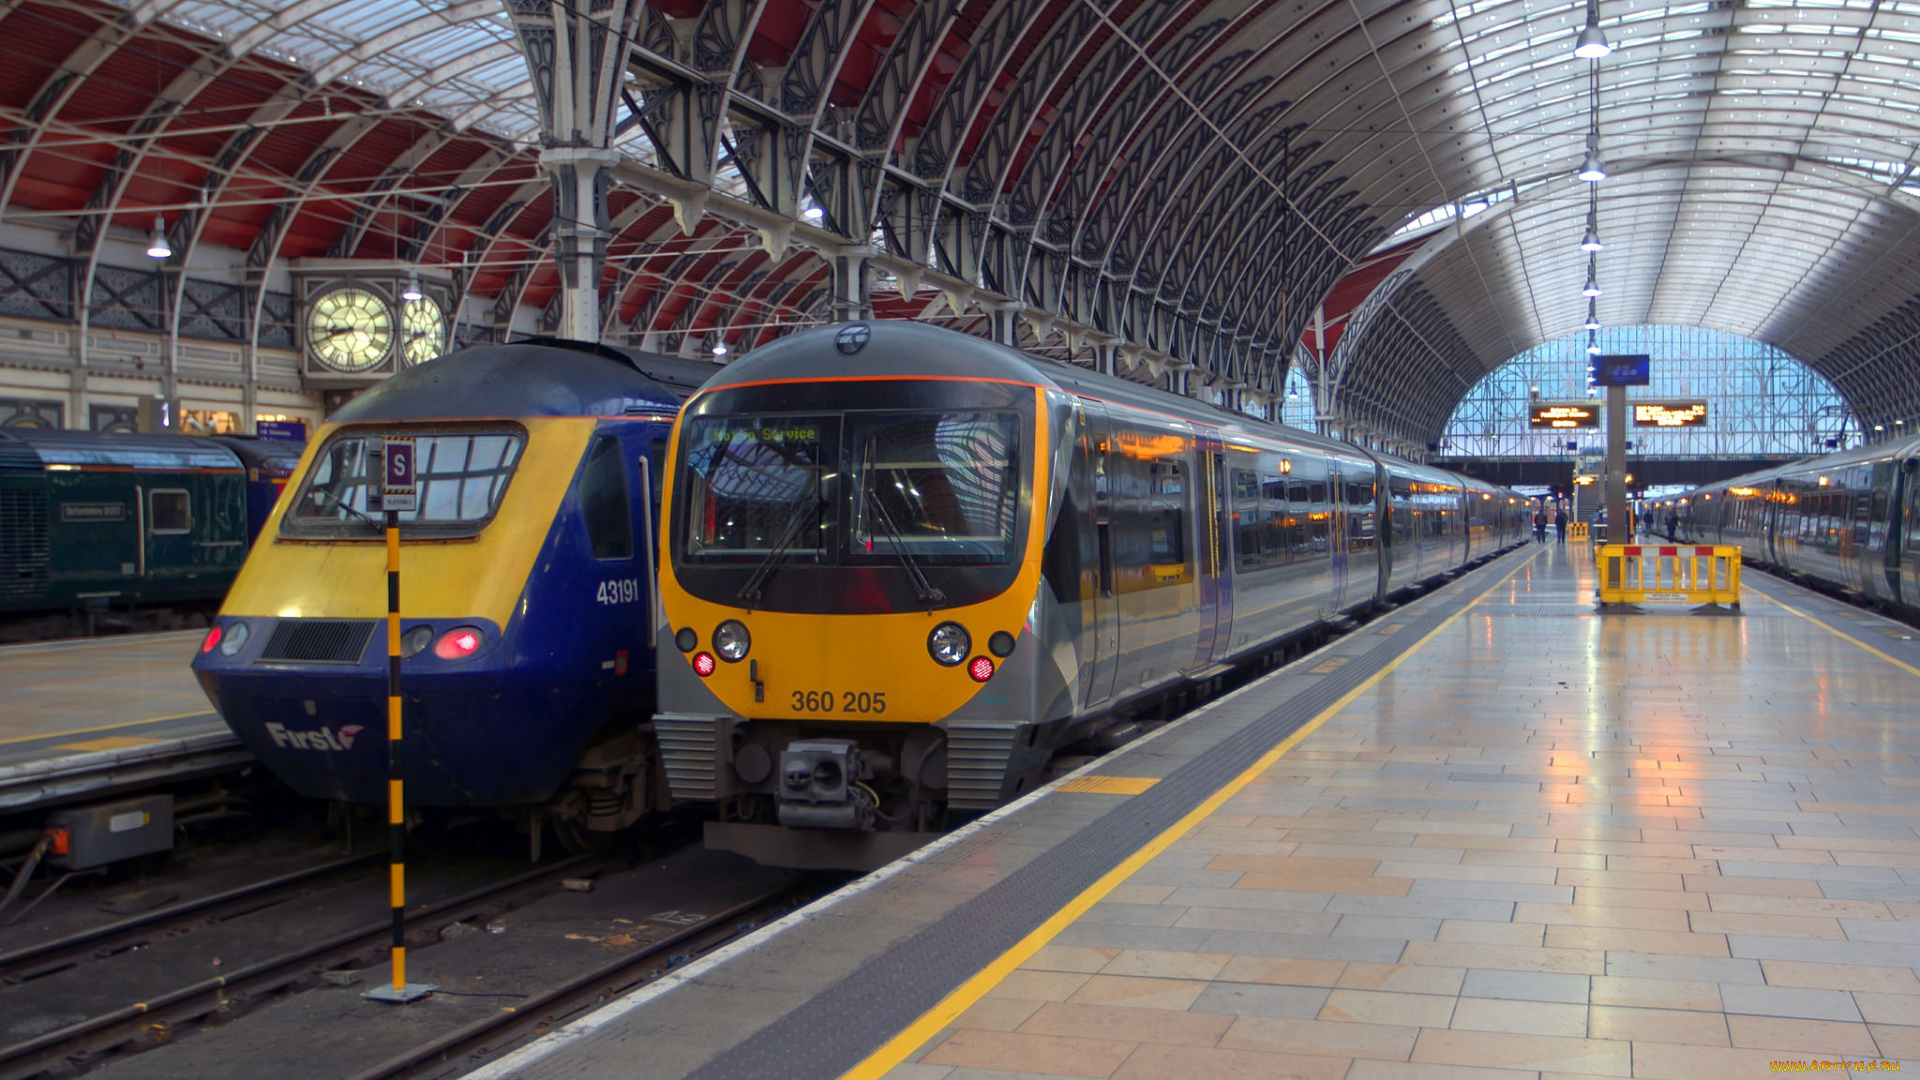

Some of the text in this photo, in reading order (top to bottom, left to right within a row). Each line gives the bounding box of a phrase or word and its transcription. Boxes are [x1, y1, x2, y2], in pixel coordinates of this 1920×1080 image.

[762, 422, 815, 441] Service
[394, 453, 406, 477] S
[597, 578, 638, 605] 43191
[791, 690, 886, 714] 360 205
[264, 722, 344, 751] First
